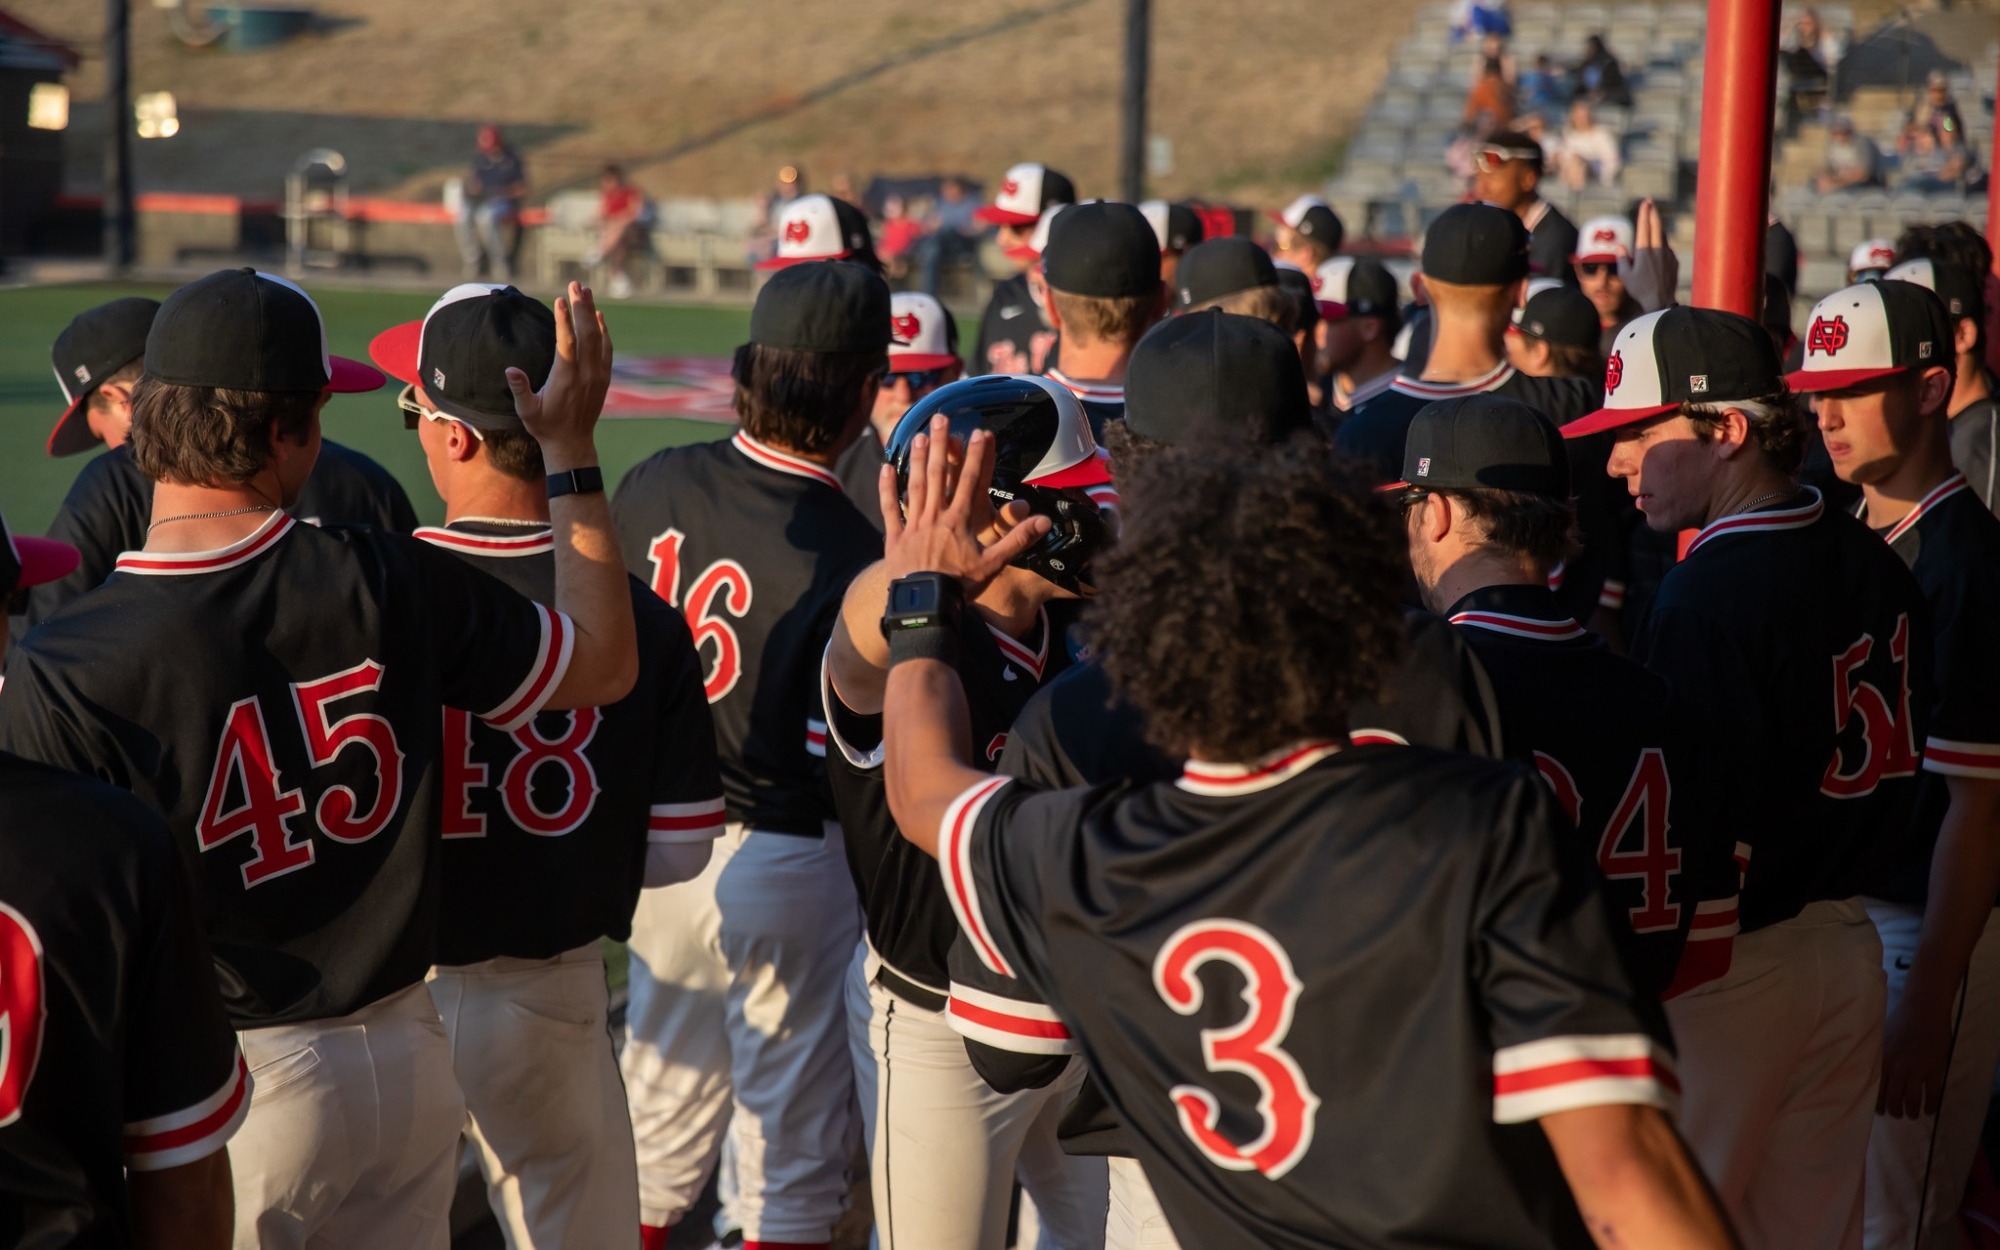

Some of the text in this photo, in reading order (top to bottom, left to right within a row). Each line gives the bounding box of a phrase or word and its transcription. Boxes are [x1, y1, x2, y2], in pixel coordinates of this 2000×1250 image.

[647, 527, 753, 704] 16
[1819, 612, 1919, 799] 51
[196, 657, 406, 890] 45
[1533, 748, 1682, 935] 4
[1152, 917, 1322, 1181] 3
